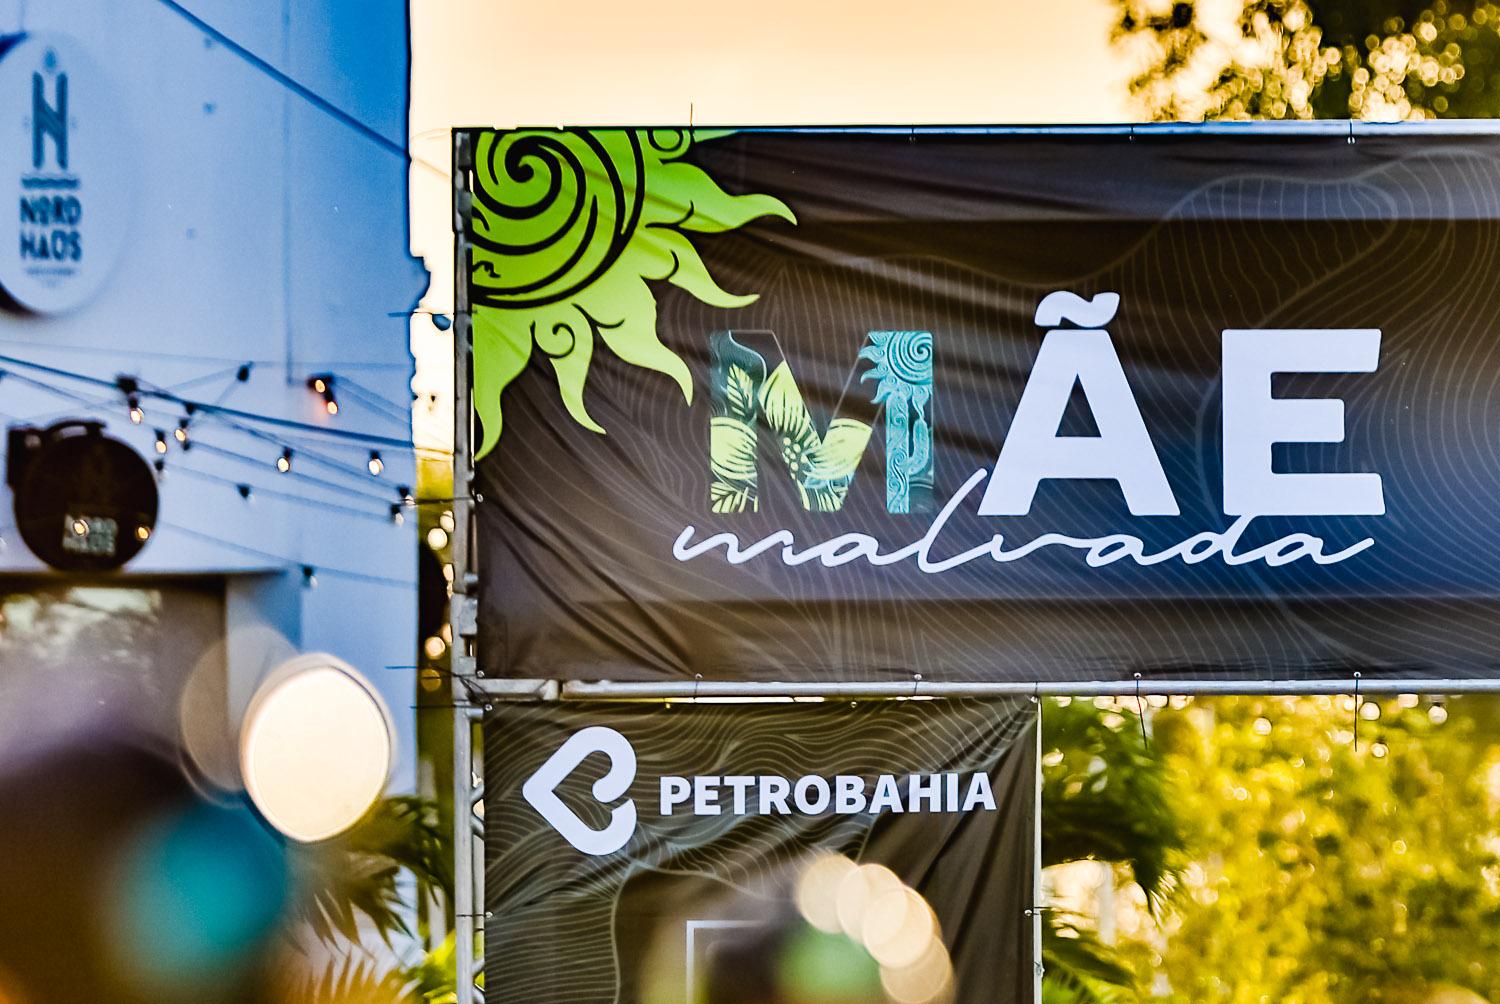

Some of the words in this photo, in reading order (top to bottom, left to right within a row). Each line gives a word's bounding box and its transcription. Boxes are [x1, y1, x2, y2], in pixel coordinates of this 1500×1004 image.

[709, 290, 1386, 516] MÃE
[672, 468, 1376, 574] malvada
[659, 771, 997, 816] PETROBAHIA
